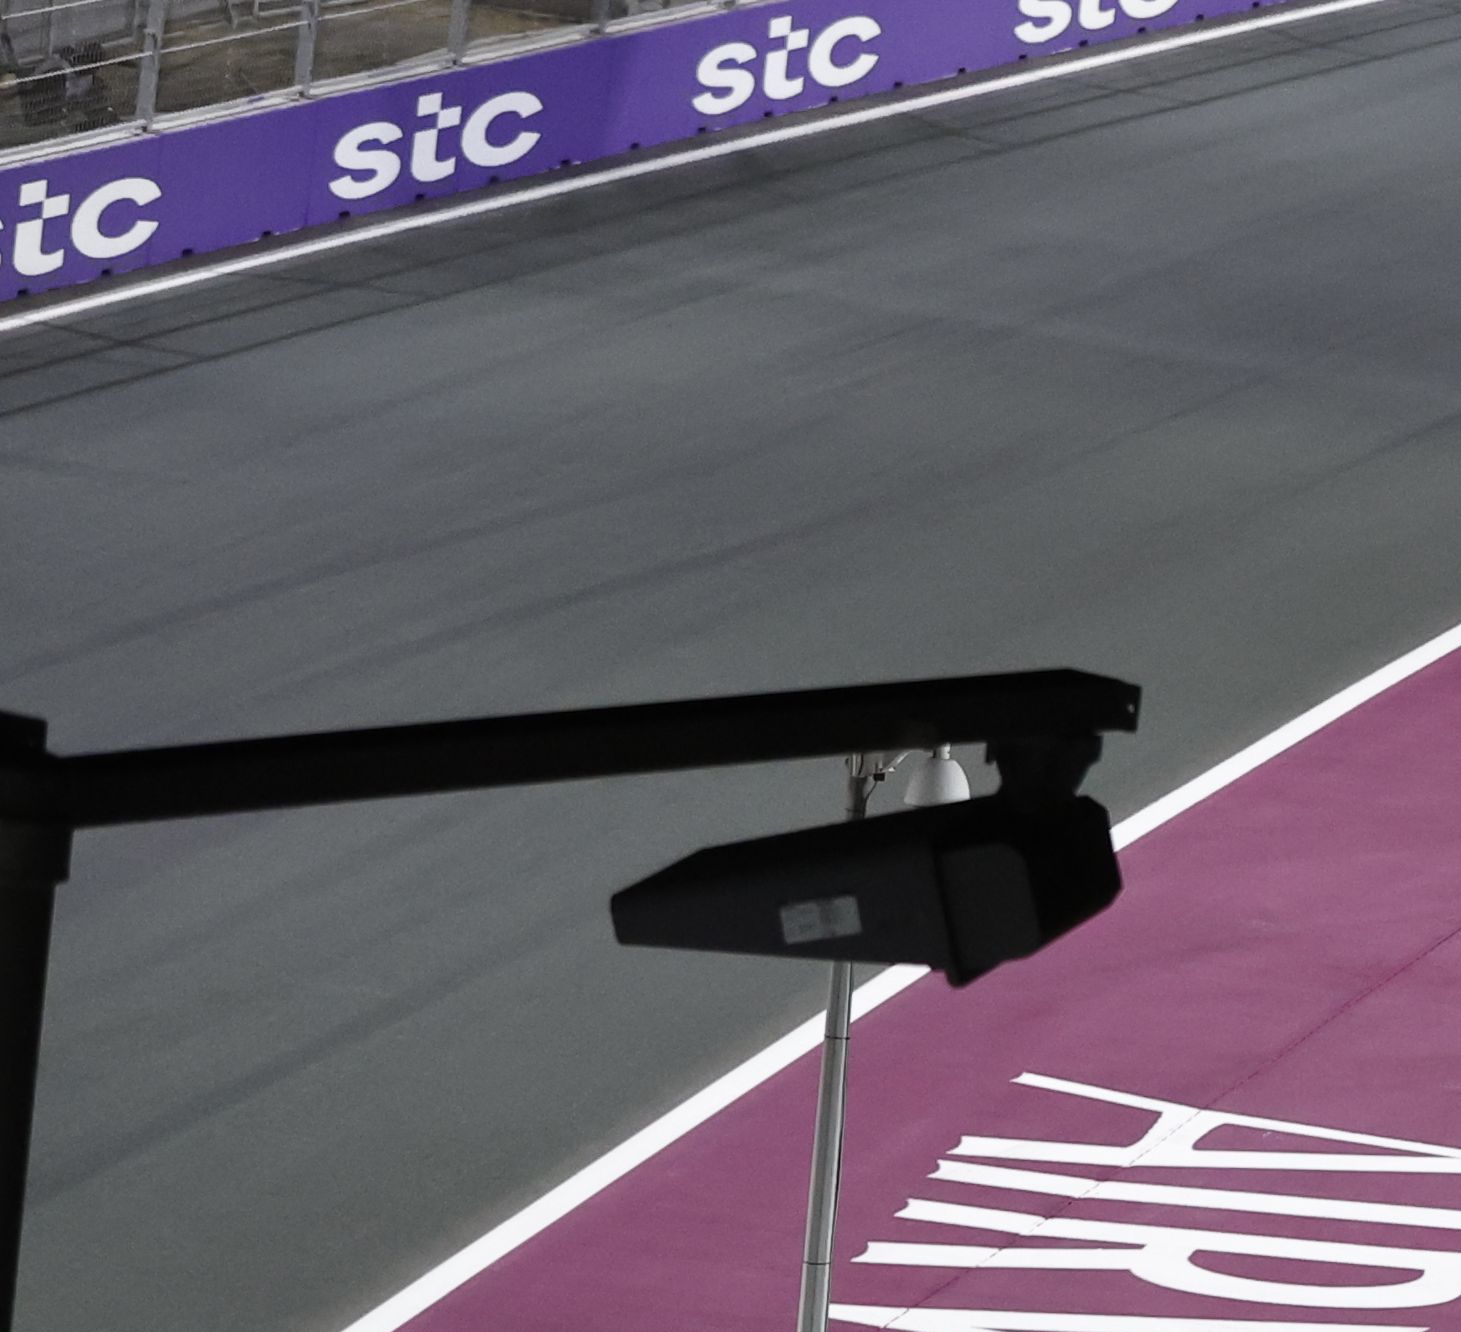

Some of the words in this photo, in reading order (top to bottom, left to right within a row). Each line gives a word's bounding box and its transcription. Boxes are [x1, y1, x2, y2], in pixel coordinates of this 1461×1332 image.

[691, 15, 882, 117] stc
[329, 90, 543, 200] stc
[0, 177, 162, 276] tc
